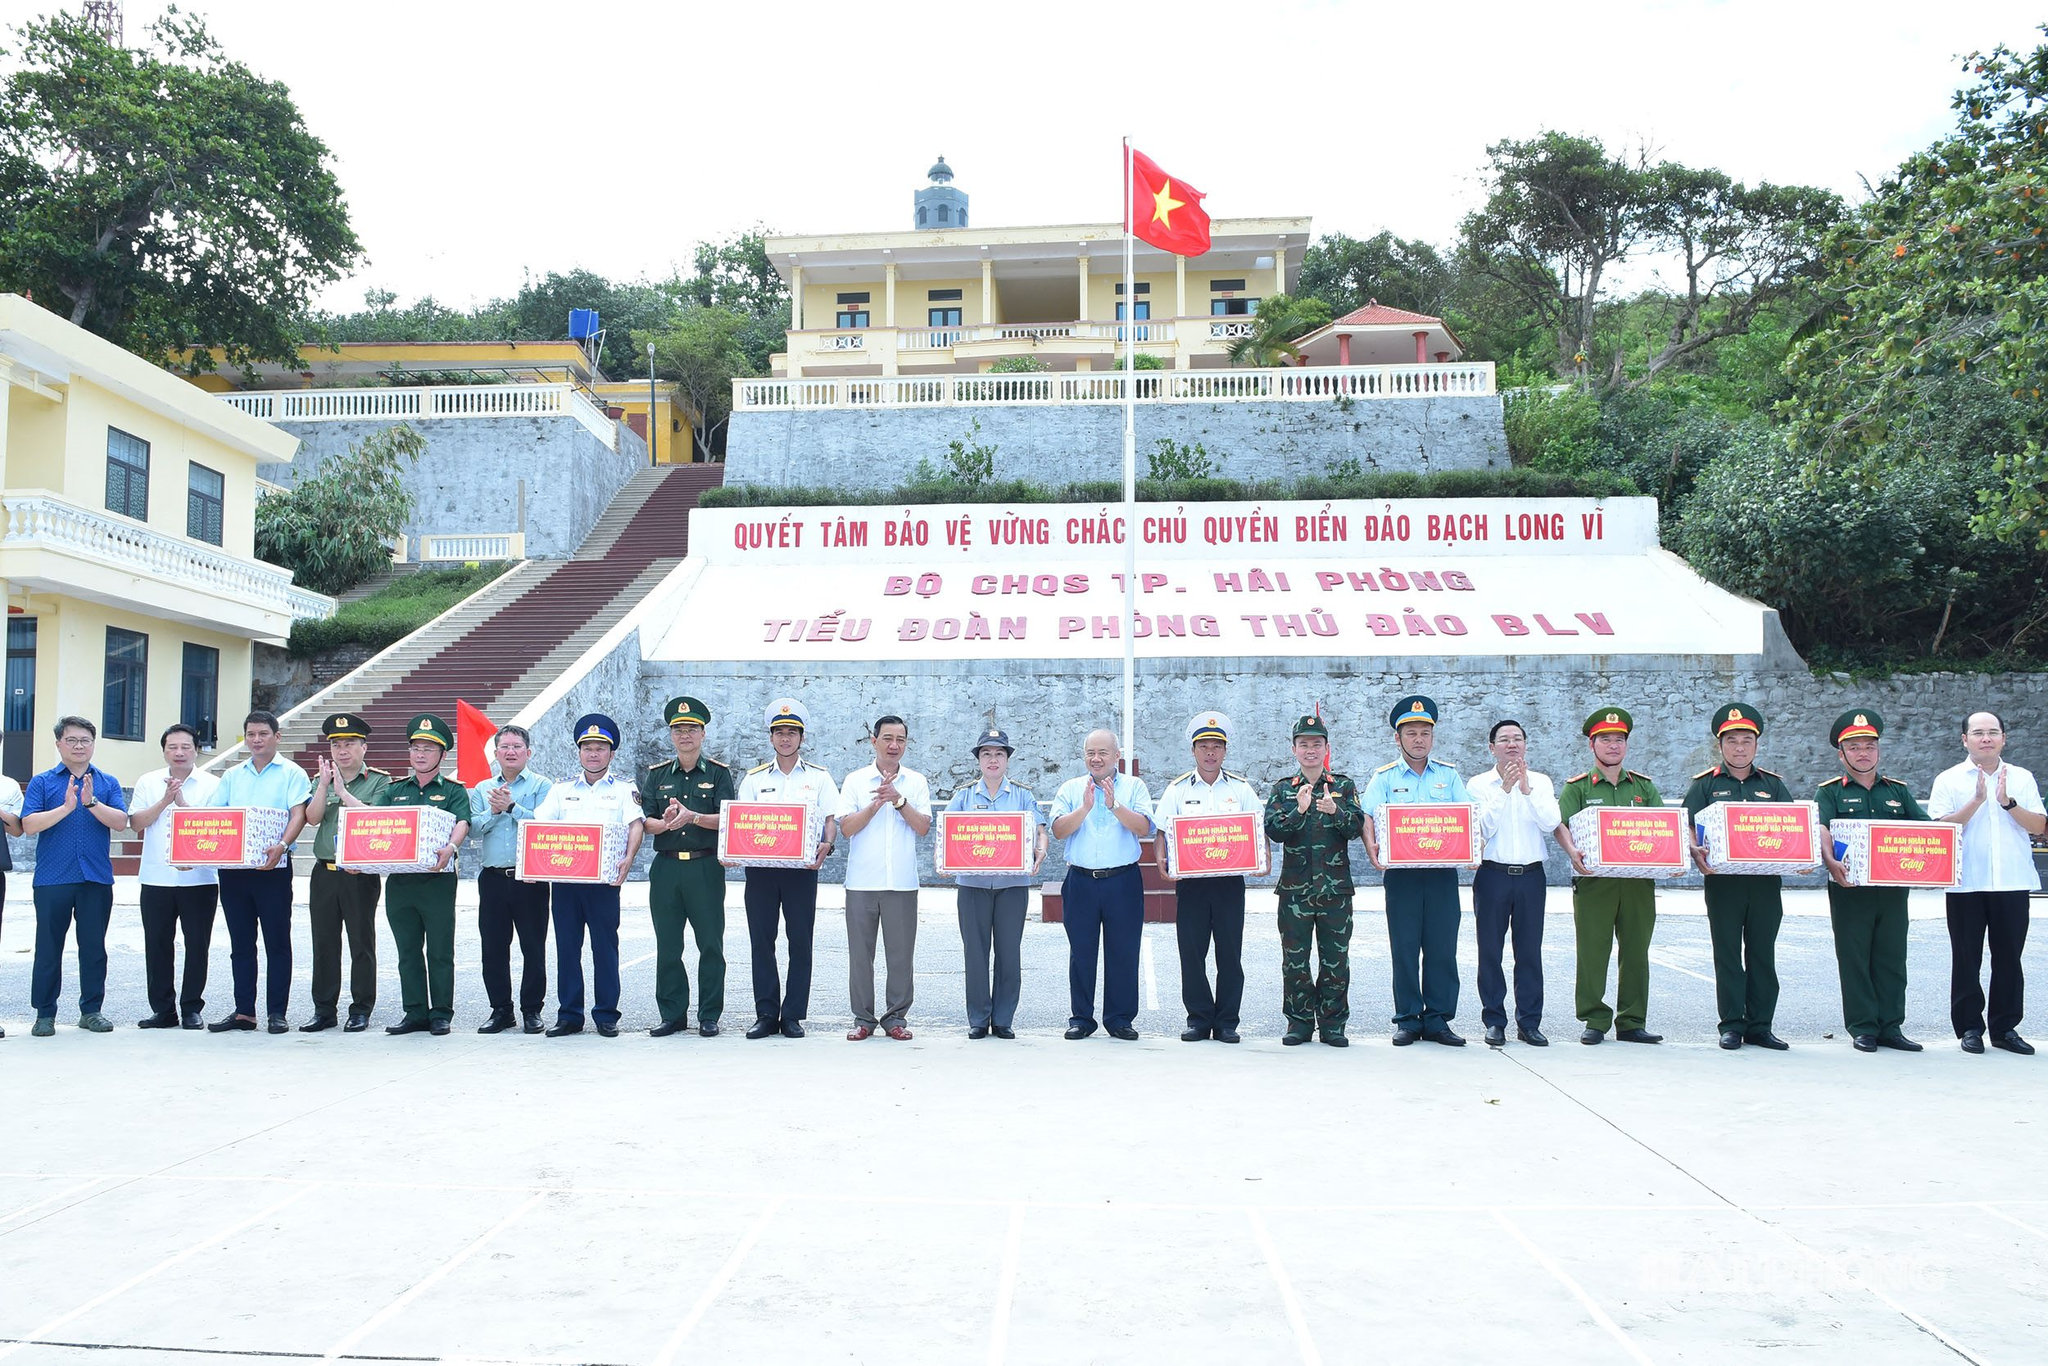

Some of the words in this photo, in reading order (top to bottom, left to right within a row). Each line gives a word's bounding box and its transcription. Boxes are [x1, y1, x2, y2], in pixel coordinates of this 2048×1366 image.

[734, 513, 803, 551] QUYẾT
[821, 517, 868, 547] TÂM
[885, 510, 928, 547] BẢO
[946, 514, 971, 552] VỆ
[989, 511, 1049, 545] VỮNG
[1067, 506, 1125, 544] CHẮC
[1143, 506, 1187, 544] CHỦ
[1204, 506, 1278, 544] QUYỀN
[1296, 503, 1347, 542] BIỂN
[1365, 504, 1410, 542] ĐẢO
[1428, 514, 1488, 547] BẠCH
[1505, 513, 1564, 541] LONG
[1582, 507, 1604, 540] VĨ
[884, 572, 942, 598] BỘ
[971, 574, 1089, 596] CHQS
[1214, 568, 1290, 592] HẢI
[1316, 567, 1475, 592] PHÒNG
[763, 609, 872, 642] TIỂU
[898, 610, 1027, 641] ĐOÀN
[1059, 609, 1221, 640] PHÒNG
[1241, 606, 1340, 638] THỦ
[1366, 606, 1468, 636] ĐẢO
[1491, 612, 1615, 636] BLV
[1197, 827, 1210, 835] BAN
